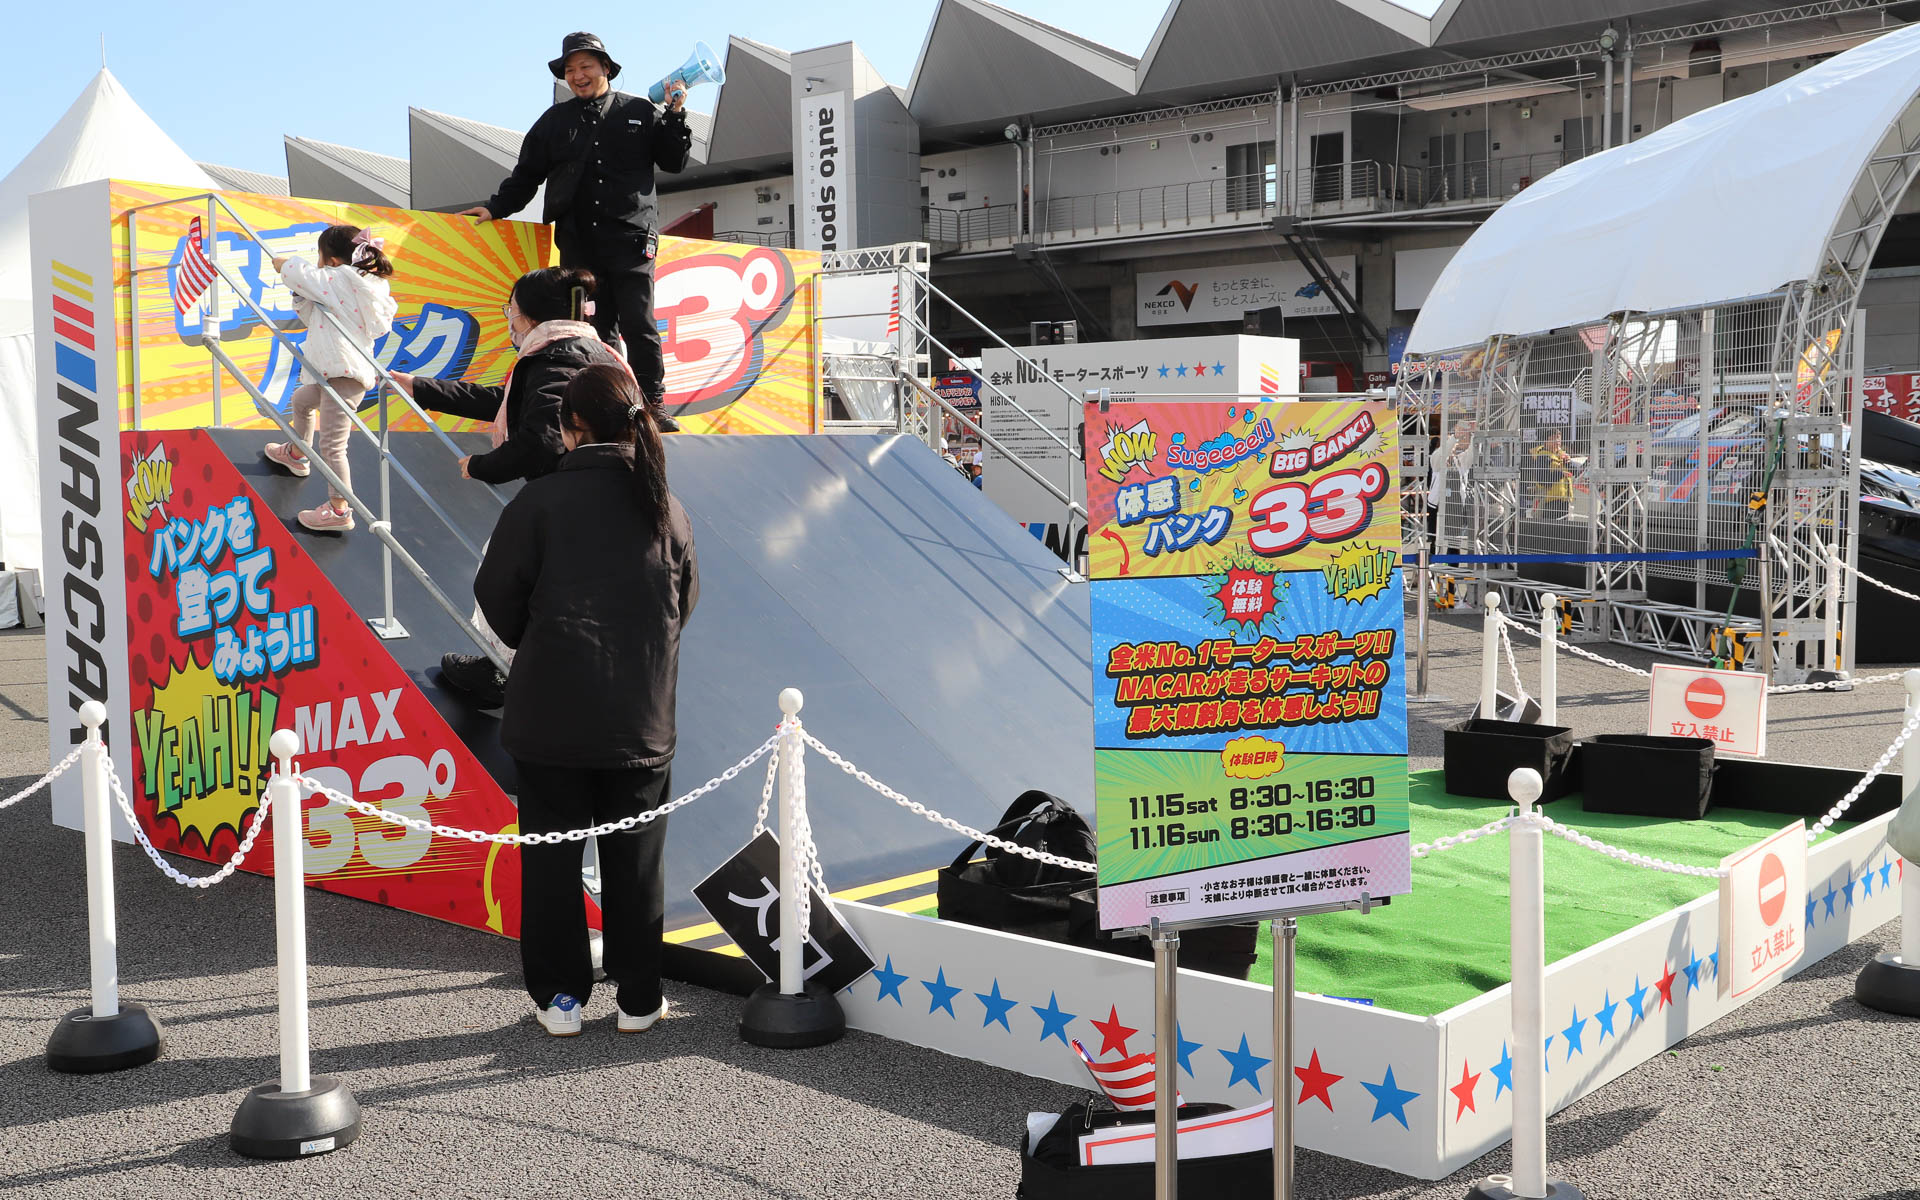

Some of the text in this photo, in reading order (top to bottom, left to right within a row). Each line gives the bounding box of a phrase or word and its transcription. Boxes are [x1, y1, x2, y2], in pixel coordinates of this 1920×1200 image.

[819, 108, 838, 178] auto
[1144, 300, 1175, 309] NEXCO
[1212, 278, 1275, 293] もっと安全に、
[1212, 291, 1287, 307] もっとスムーズに
[990, 358, 1149, 386] 全米 NO.1 モータースポーツ
[1368, 374, 1387, 382] Gate
[1523, 395, 1570, 410] FRENCH
[1536, 410, 1570, 424] FRIES
[1099, 431, 1158, 482] WOW
[1167, 419, 1273, 468] Sugeeee!!
[1273, 412, 1373, 473] BIG BANK!!
[126, 459, 174, 533] WOW
[1116, 479, 1177, 521] 体感
[152, 497, 255, 574] バンクを
[1145, 508, 1229, 551] バンク
[179, 550, 272, 634] 登って
[1231, 579, 1263, 597] 体験
[1322, 551, 1397, 595] YEAH!!
[1230, 596, 1263, 613] 無料
[214, 606, 314, 679] みよう!!
[1109, 631, 1393, 671] 全米No.1モータースポーツ!!
[1117, 662, 1387, 701] NACARが走るサーキットの
[295, 688, 405, 754] MAX
[1128, 691, 1377, 732] 最大傾斜角を体感しよう!!
[134, 690, 279, 808] YEAH!!
[1670, 721, 1735, 743] 立入禁止
[1229, 750, 1278, 767] 体験日時
[1129, 793, 1185, 820] 11.15
[1187, 797, 1218, 815] sat
[1129, 823, 1186, 850] 11.16
[1187, 827, 1220, 844] sun
[1150, 891, 1186, 905] 注意事項
[1751, 924, 1795, 972] 立入禁止
